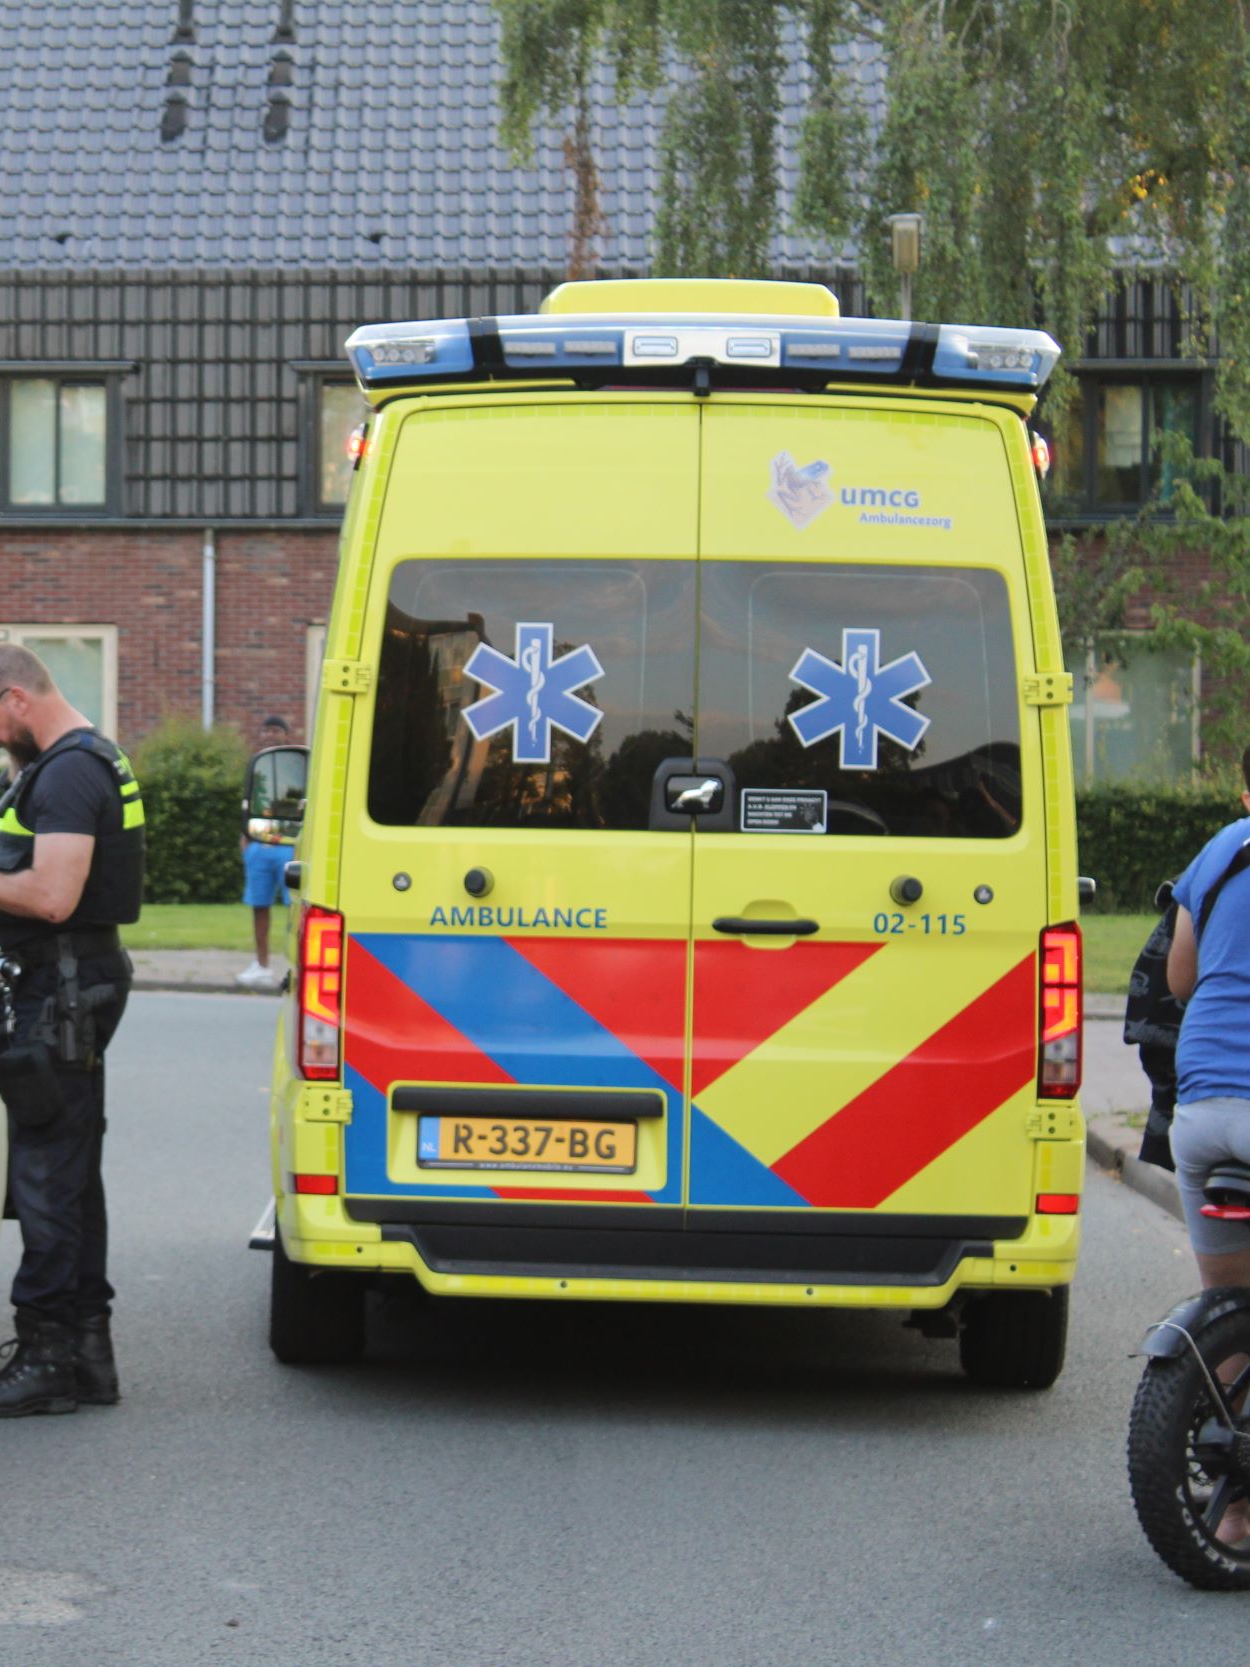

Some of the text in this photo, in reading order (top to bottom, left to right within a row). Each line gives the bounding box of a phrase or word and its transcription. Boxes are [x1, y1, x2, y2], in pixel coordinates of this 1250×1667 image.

[859, 512, 952, 530] Ambulancezorg
[429, 906, 607, 929] AMBULANCE
[873, 913, 966, 935] 02-115
[422, 1142, 436, 1152] NL
[453, 1123, 617, 1160] R-337-BG
